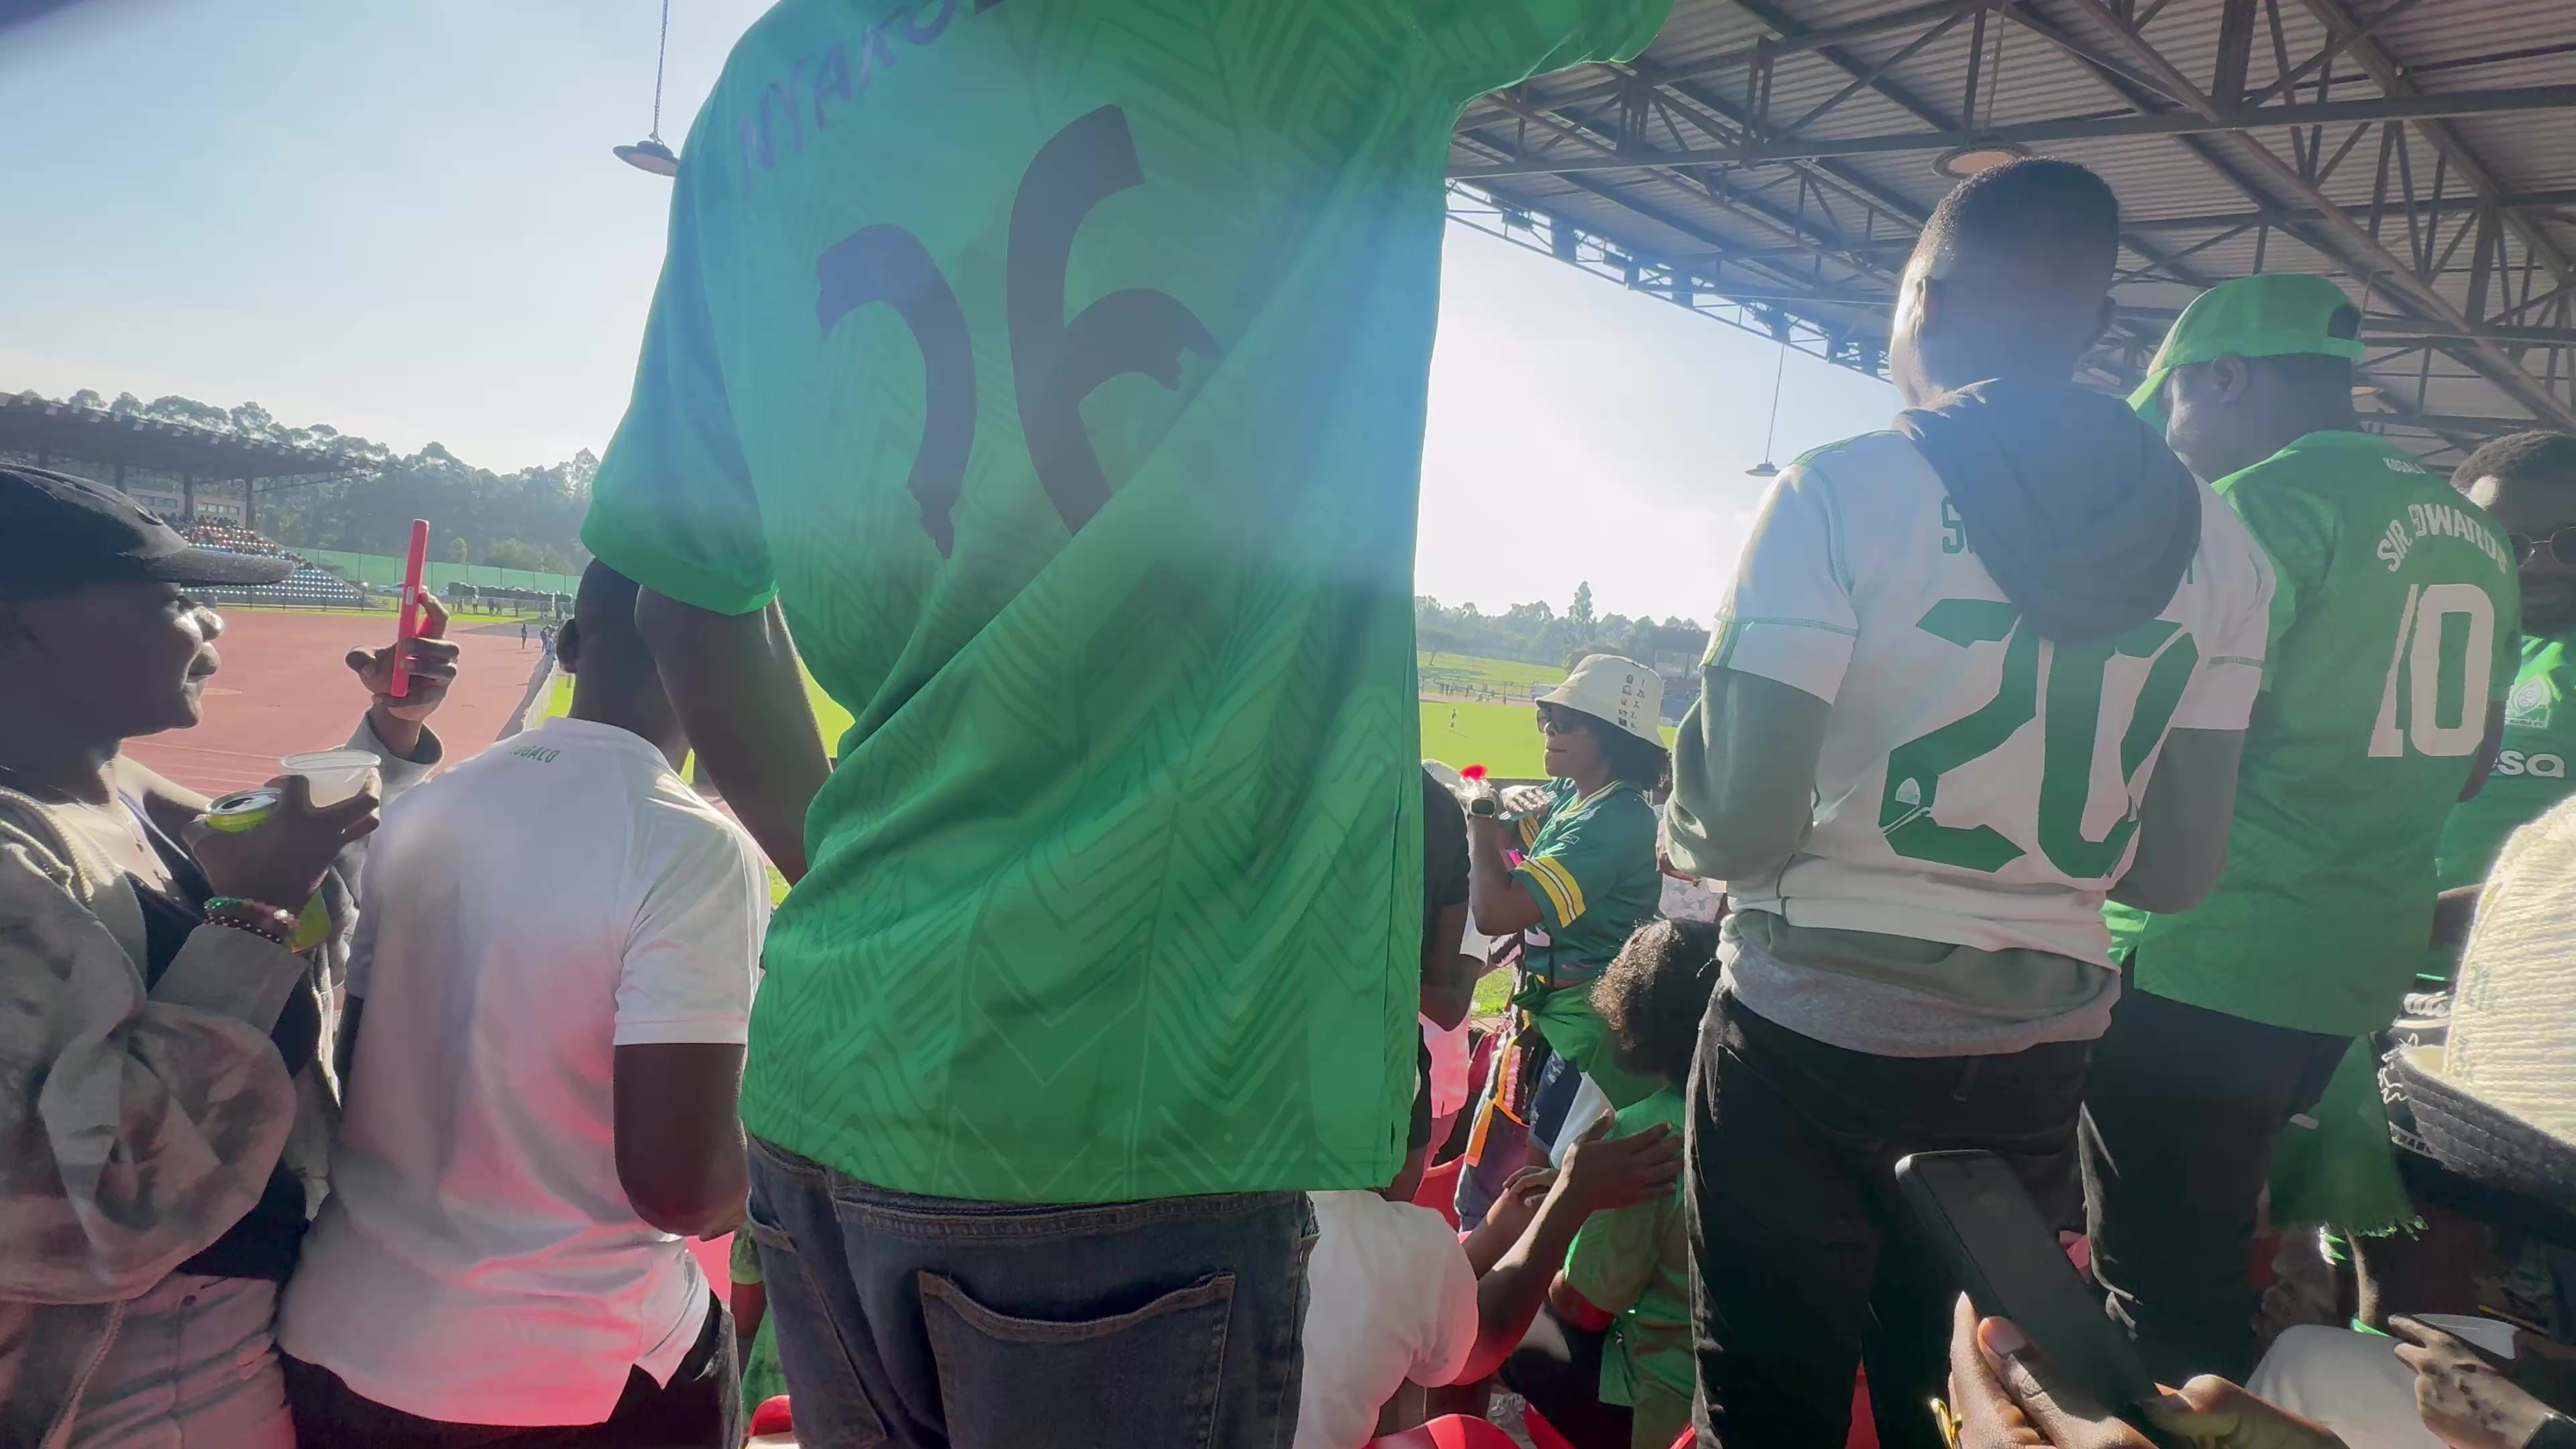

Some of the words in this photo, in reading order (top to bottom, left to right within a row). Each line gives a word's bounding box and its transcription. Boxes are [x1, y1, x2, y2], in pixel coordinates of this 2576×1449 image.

[739, 0, 1004, 195] NYAKO
[814, 104, 1226, 560] 26
[2377, 519, 2413, 572] SIR
[1878, 598, 2199, 879] 20
[2367, 584, 2495, 757] 10
[2492, 750, 2565, 778] sa
